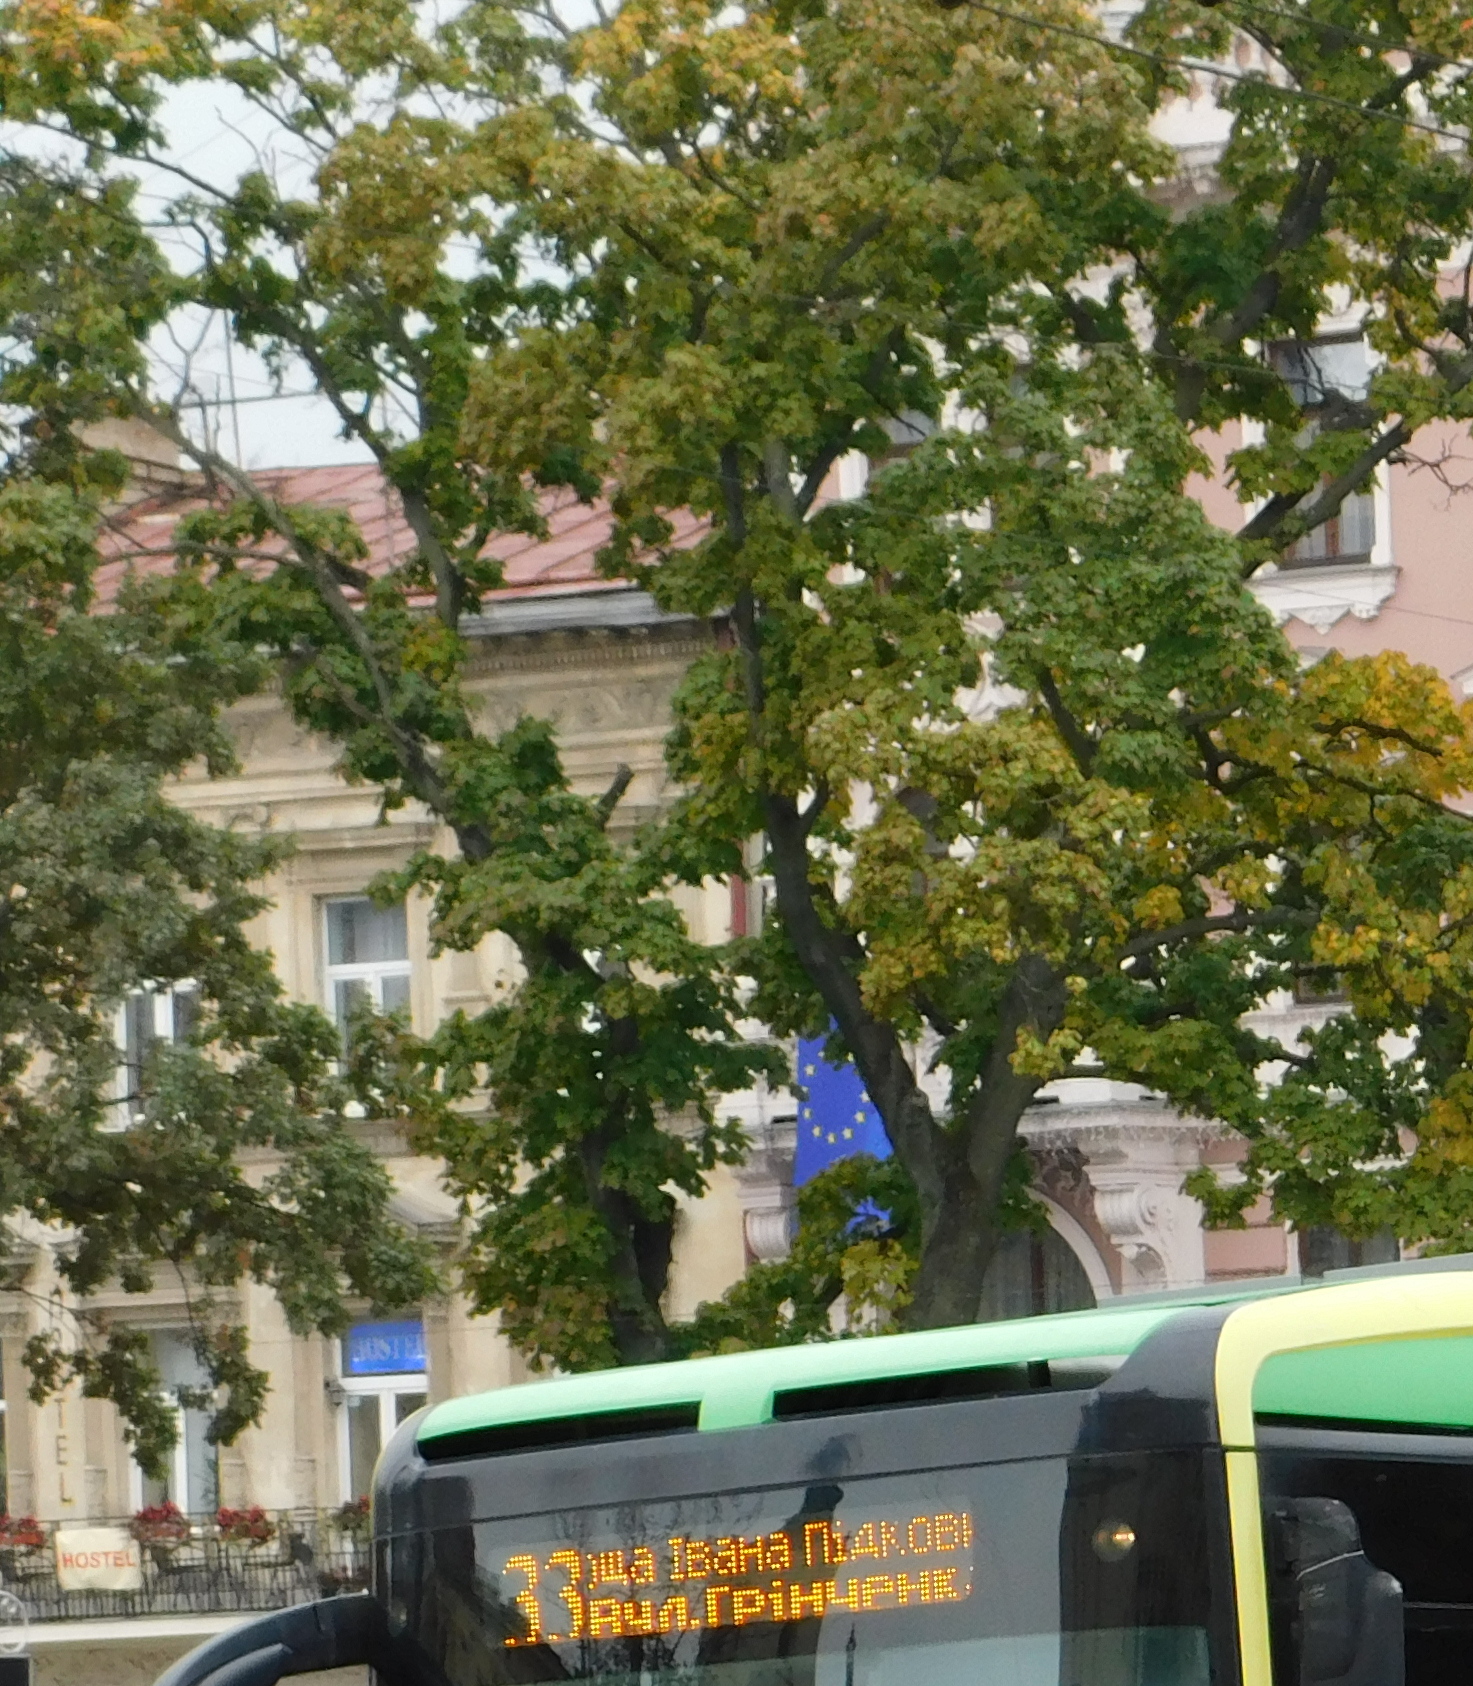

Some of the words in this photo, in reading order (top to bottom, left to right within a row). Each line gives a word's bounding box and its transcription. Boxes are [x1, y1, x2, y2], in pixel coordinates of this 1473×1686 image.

[62, 1550, 137, 1569] HOSTEL
[667, 1533, 790, 1581] Івана
[502, 1549, 584, 1645] 33
